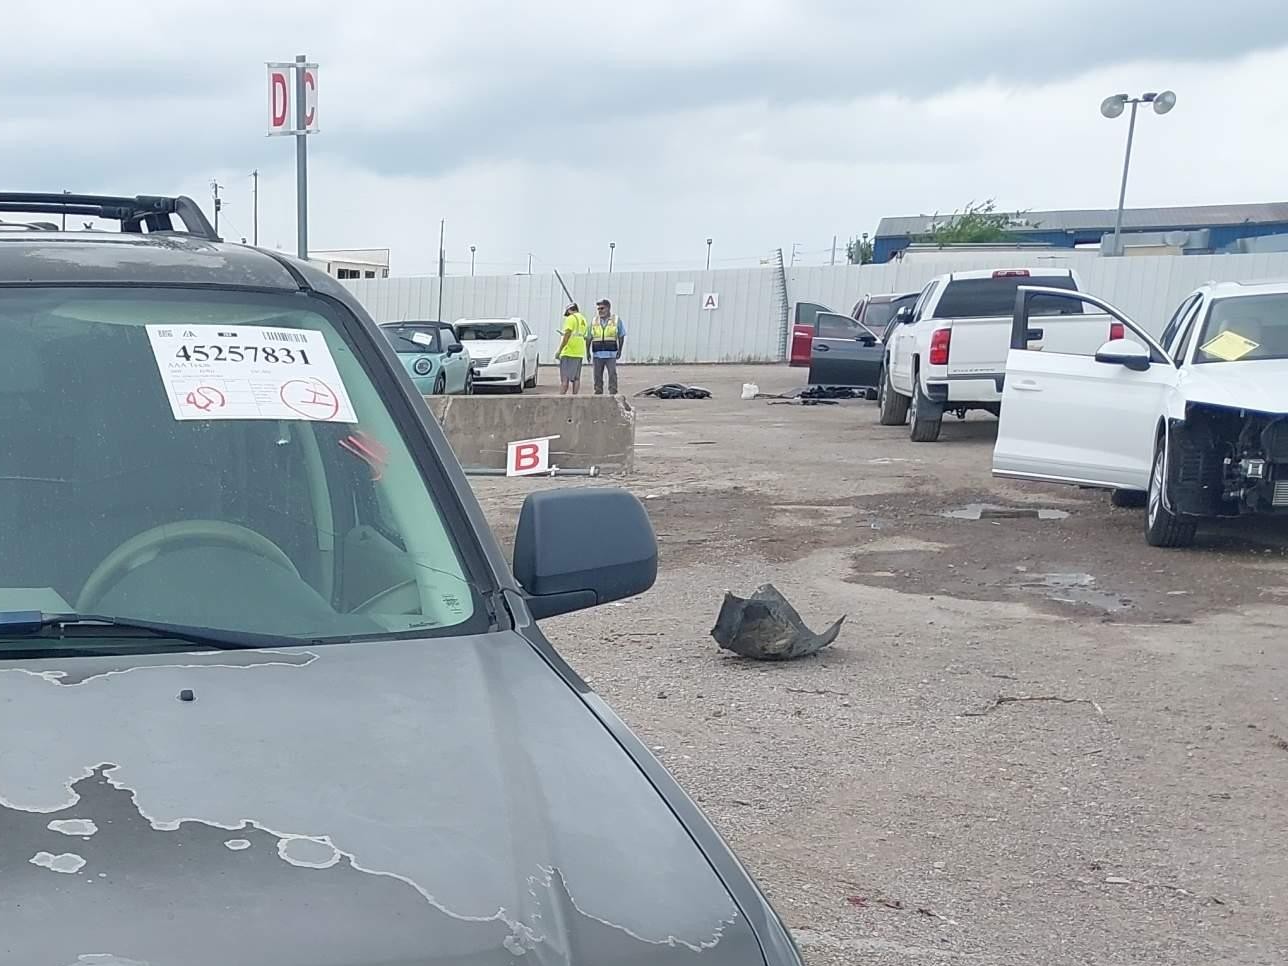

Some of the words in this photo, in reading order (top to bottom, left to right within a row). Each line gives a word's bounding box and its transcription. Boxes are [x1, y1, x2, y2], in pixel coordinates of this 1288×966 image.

[272, 73, 287, 126] D
[704, 295, 716, 308] A
[175, 345, 312, 366] 45257831
[515, 444, 539, 471] B
